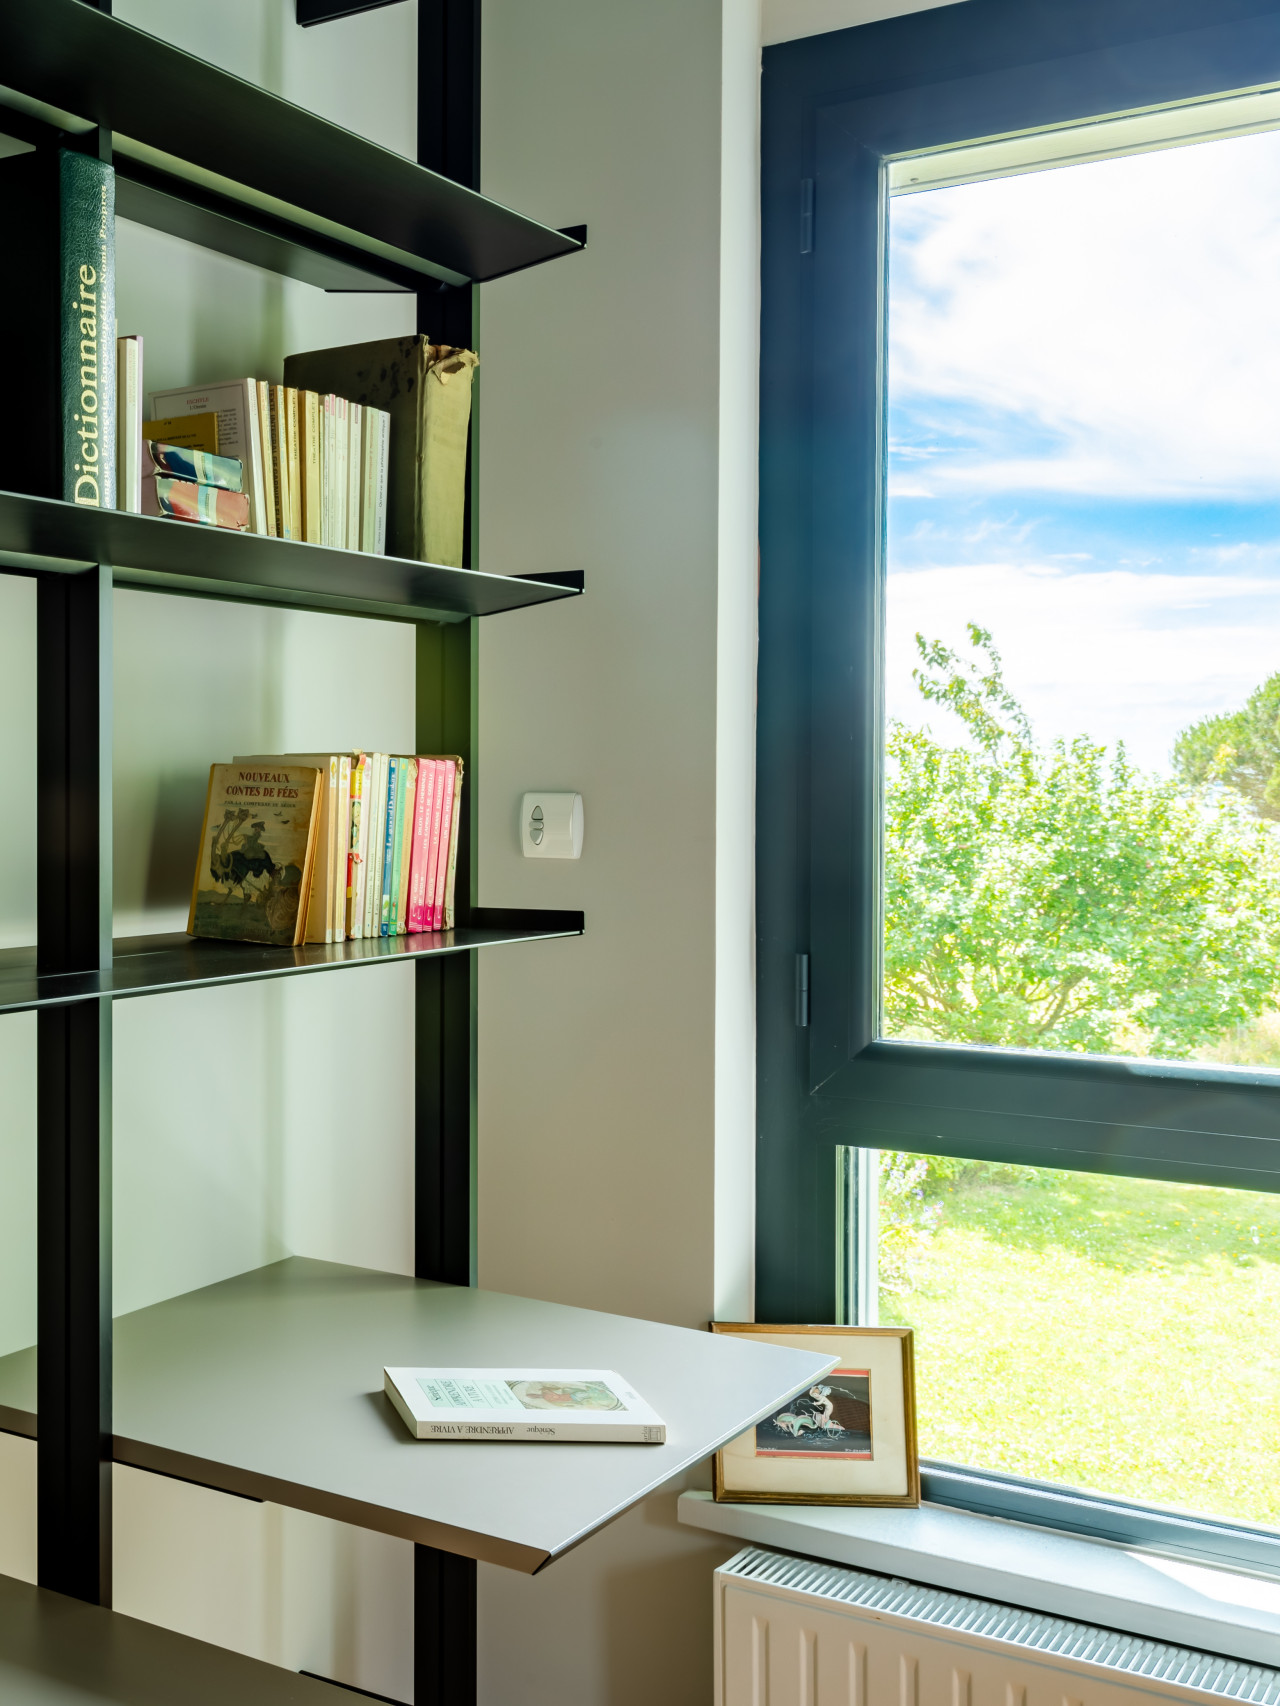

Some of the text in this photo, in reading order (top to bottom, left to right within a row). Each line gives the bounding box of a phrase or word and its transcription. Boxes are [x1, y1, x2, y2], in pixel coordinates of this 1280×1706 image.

[99, 184, 112, 508] angue Noms Propres
[71, 264, 100, 507] Dictionnaire
[238, 771, 291, 784] NOUVEAUX
[225, 785, 299, 799] CONTES DE FÉES
[430, 1424, 456, 1434] VIVRE
[464, 1425, 515, 1436] APPRENDRE
[526, 1426, 556, 1436] Sénèque
